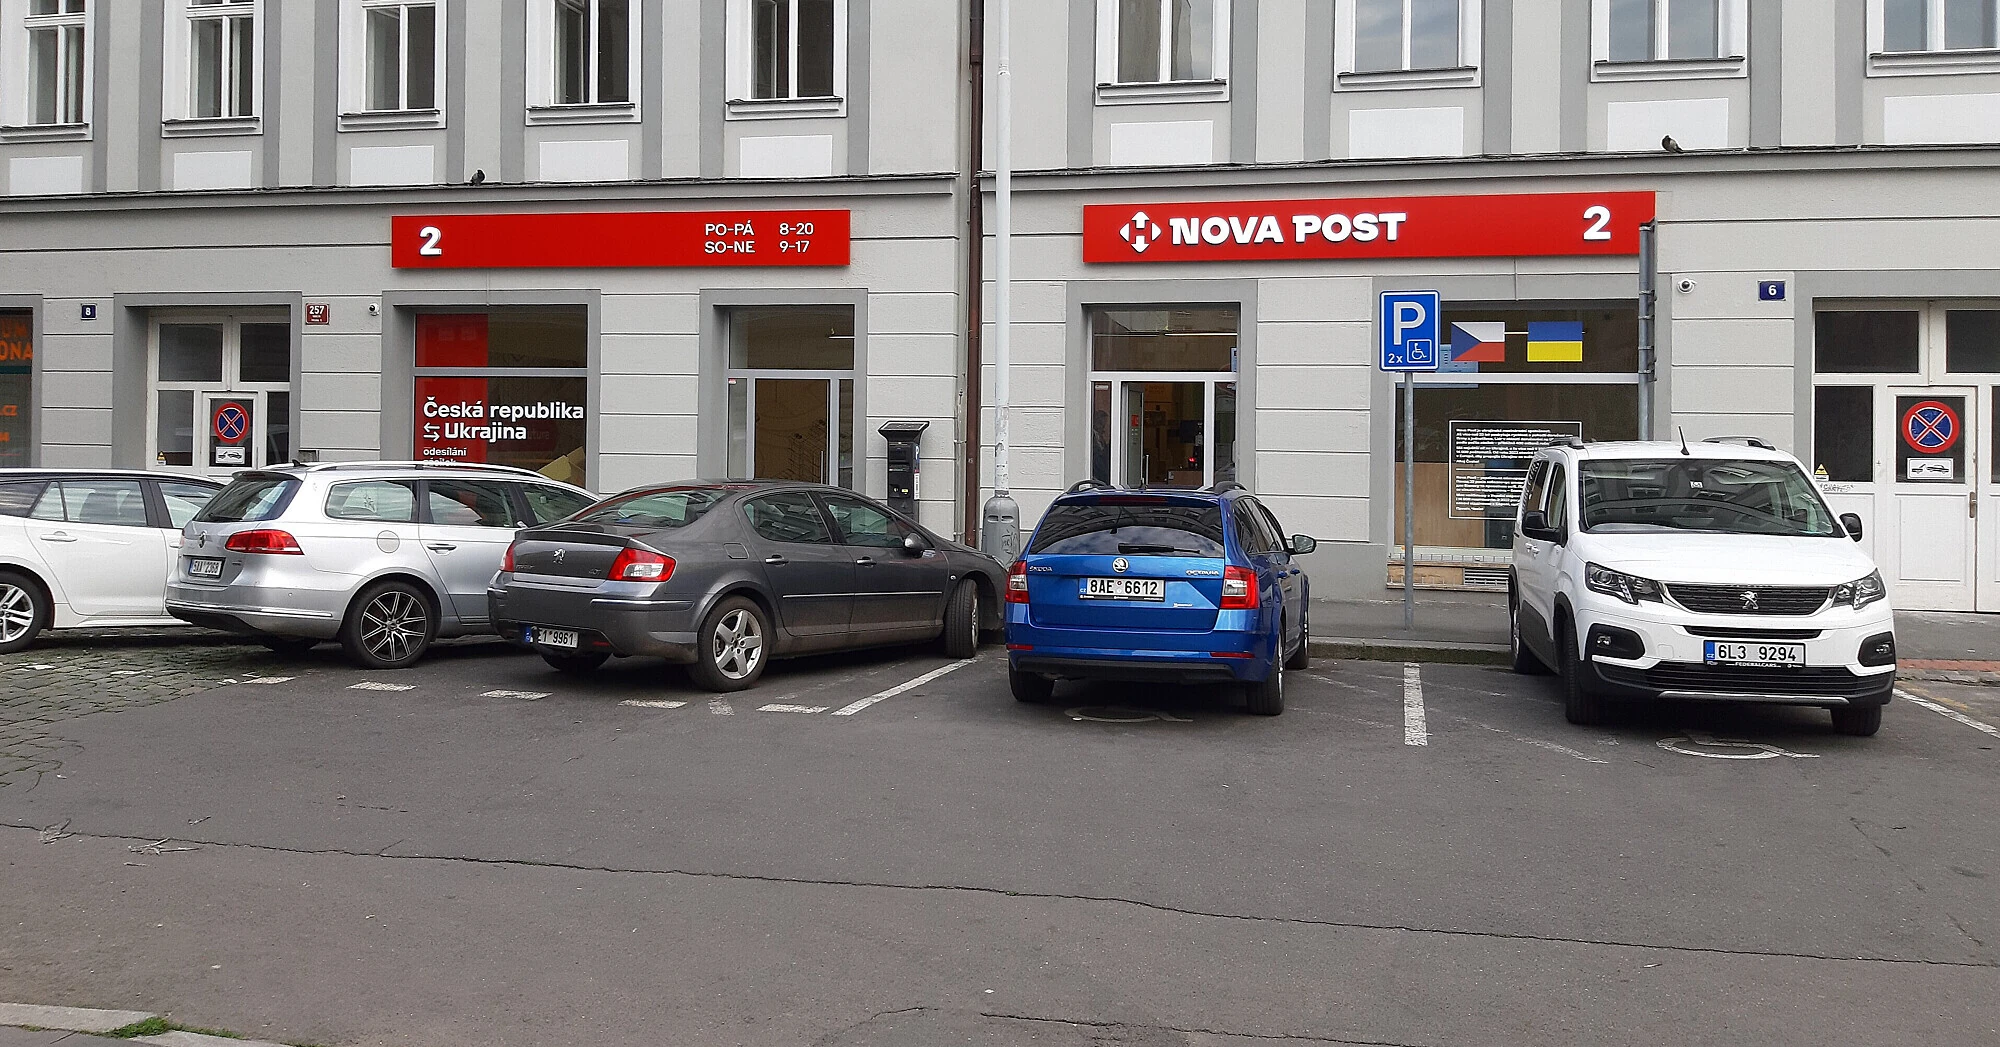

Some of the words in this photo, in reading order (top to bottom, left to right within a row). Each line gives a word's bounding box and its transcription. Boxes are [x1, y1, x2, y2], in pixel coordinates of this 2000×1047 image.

[705, 219, 755, 237] PO-PÁ
[778, 222, 815, 236] 8-20
[1169, 215, 1284, 246] NOVA
[1292, 211, 1406, 243] POST
[1582, 205, 1612, 241] 2
[419, 226, 442, 256] 2
[704, 240, 756, 254] SO-NE
[778, 239, 811, 253] 9-17
[1767, 284, 1778, 296] 6
[85, 307, 92, 316] 8
[309, 305, 325, 315] 257
[1393, 301, 1426, 346] P
[1388, 353, 1403, 364] 2x
[423, 396, 484, 418] Česká
[489, 401, 585, 422] republika
[444, 422, 527, 443] Ukrajina
[423, 446, 467, 456] odesílání
[1089, 579, 1115, 595] 8AE
[1124, 581, 1158, 596] 6612
[552, 630, 574, 646] 9961
[1718, 644, 1747, 660] 6L3
[1758, 646, 1797, 662] 9294
